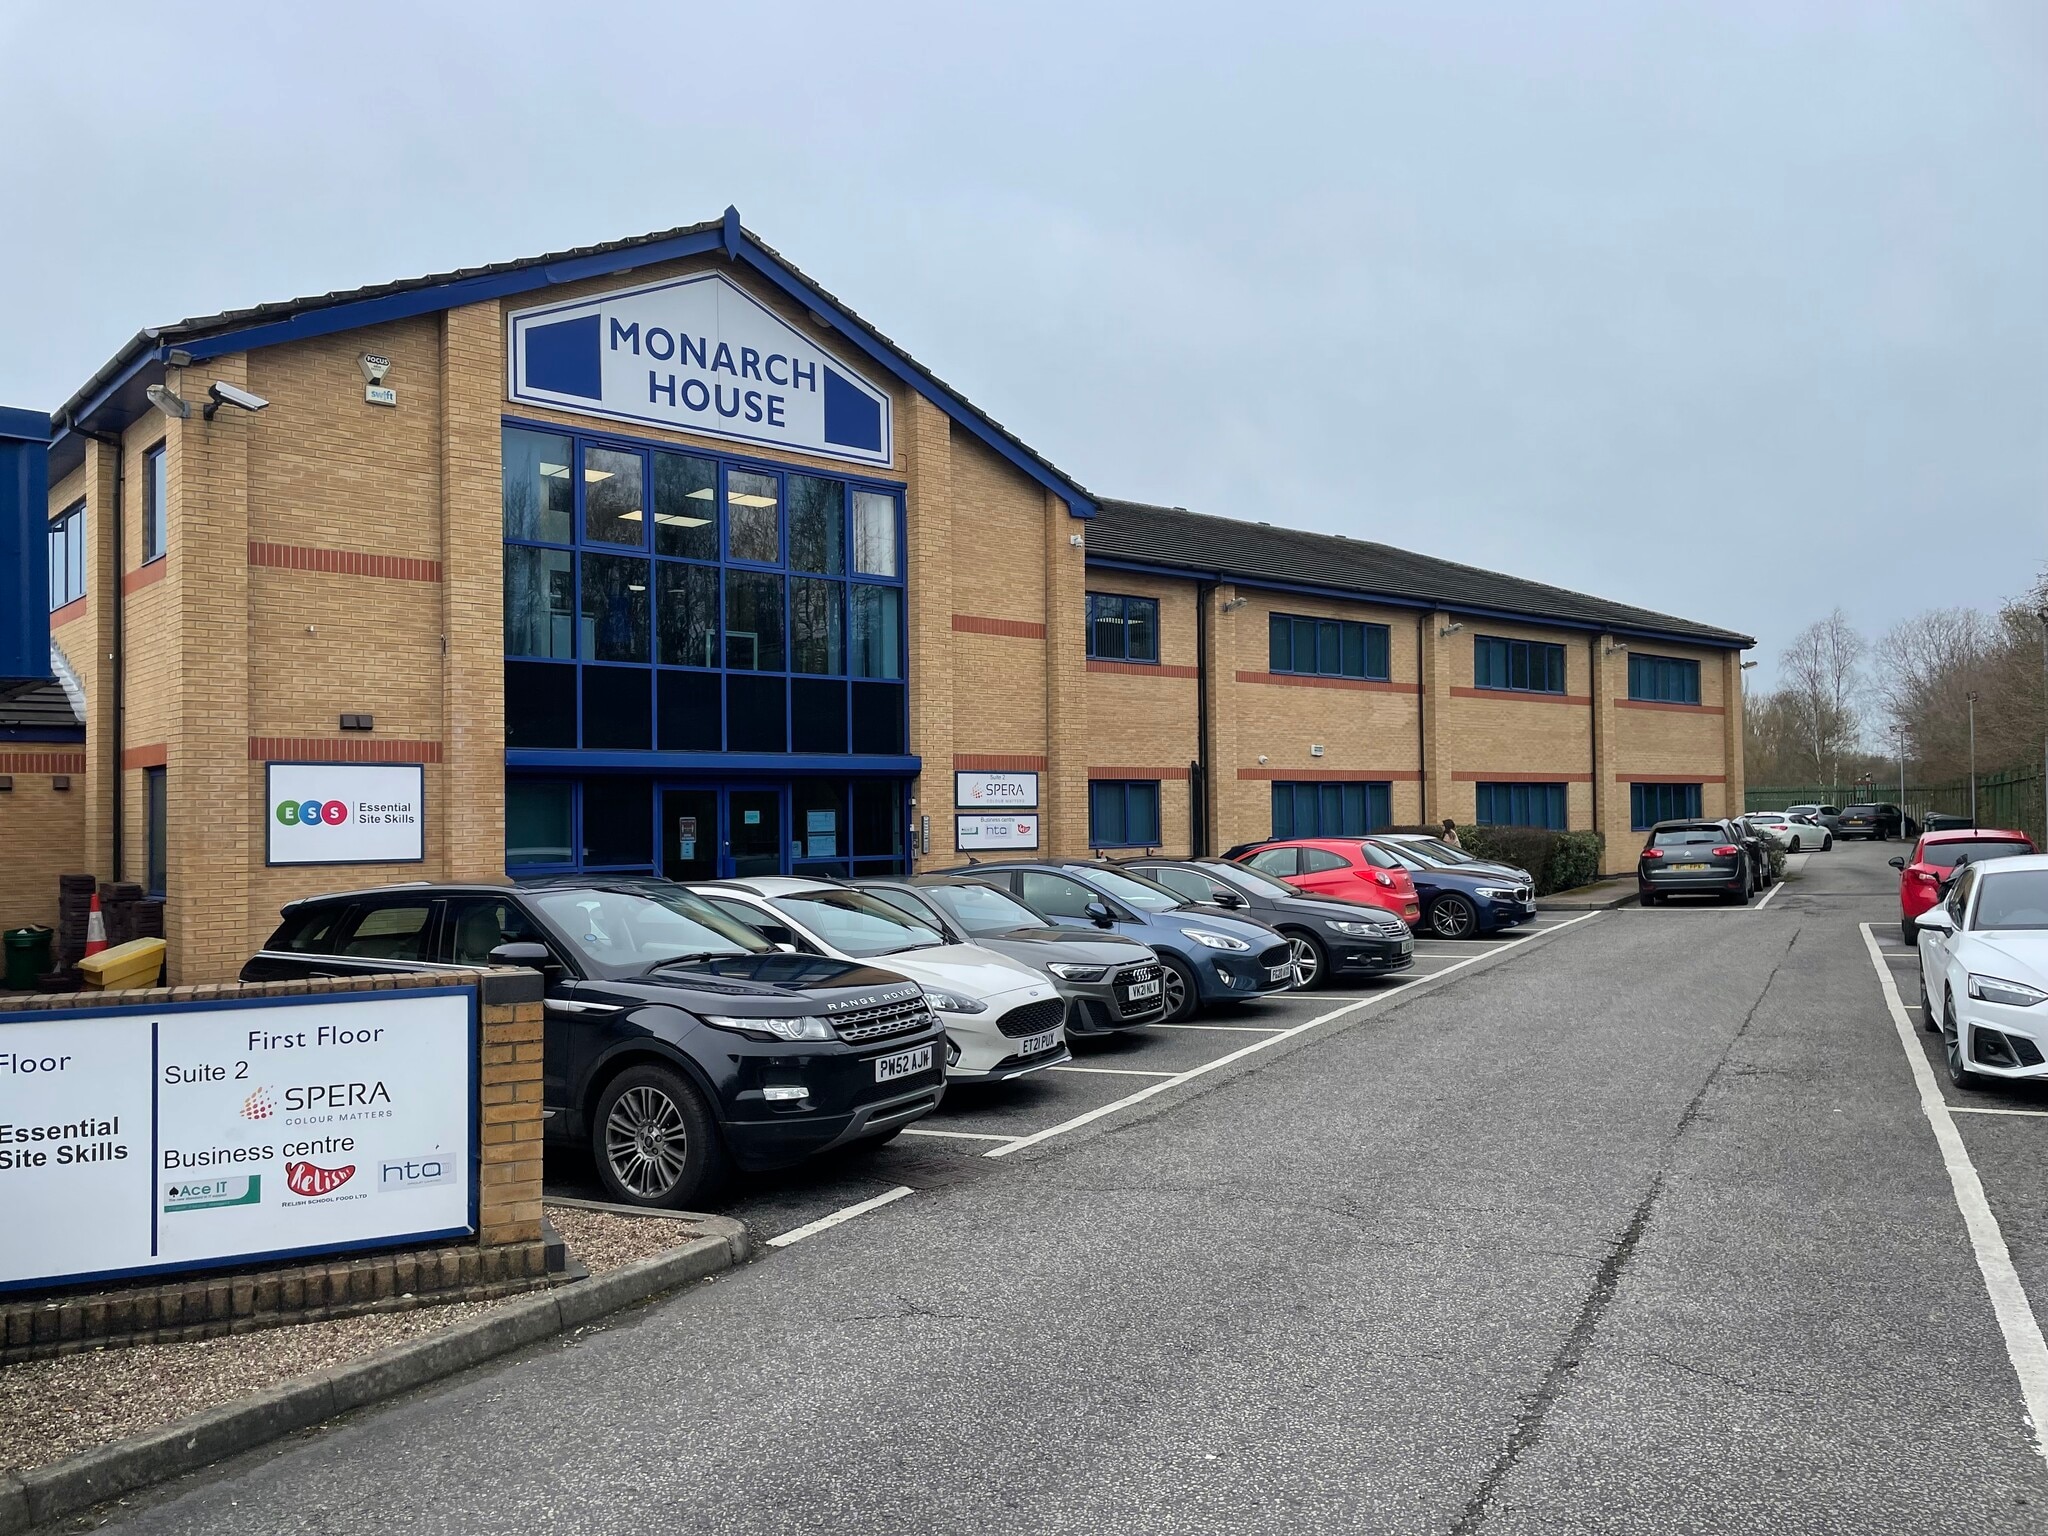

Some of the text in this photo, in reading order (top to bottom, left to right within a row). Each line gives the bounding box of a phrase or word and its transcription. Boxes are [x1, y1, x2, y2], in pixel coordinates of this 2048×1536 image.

[367, 355, 389, 365] FOCUS
[610, 317, 816, 392] MONARCH
[649, 370, 786, 428] HOUSE
[986, 783, 1024, 796] SPERA
[359, 802, 411, 812] Essential
[359, 814, 415, 824] Site Skills
[827, 987, 917, 1011] RANGE ROVER
[248, 1026, 384, 1051] First Floor
[164, 1060, 249, 1084] Suite 2
[285, 1081, 392, 1111] SPERA
[285, 1109, 393, 1126] COLOUR MATTERS
[0, 1116, 119, 1144] Essential
[0, 1142, 128, 1170] Site Skills
[164, 1135, 355, 1170] Business centre
[383, 1161, 441, 1183] hta
[180, 1181, 228, 1197] Ace IT
[281, 1200, 307, 1208] RELISH
[308, 1197, 334, 1205] SCHOOL
